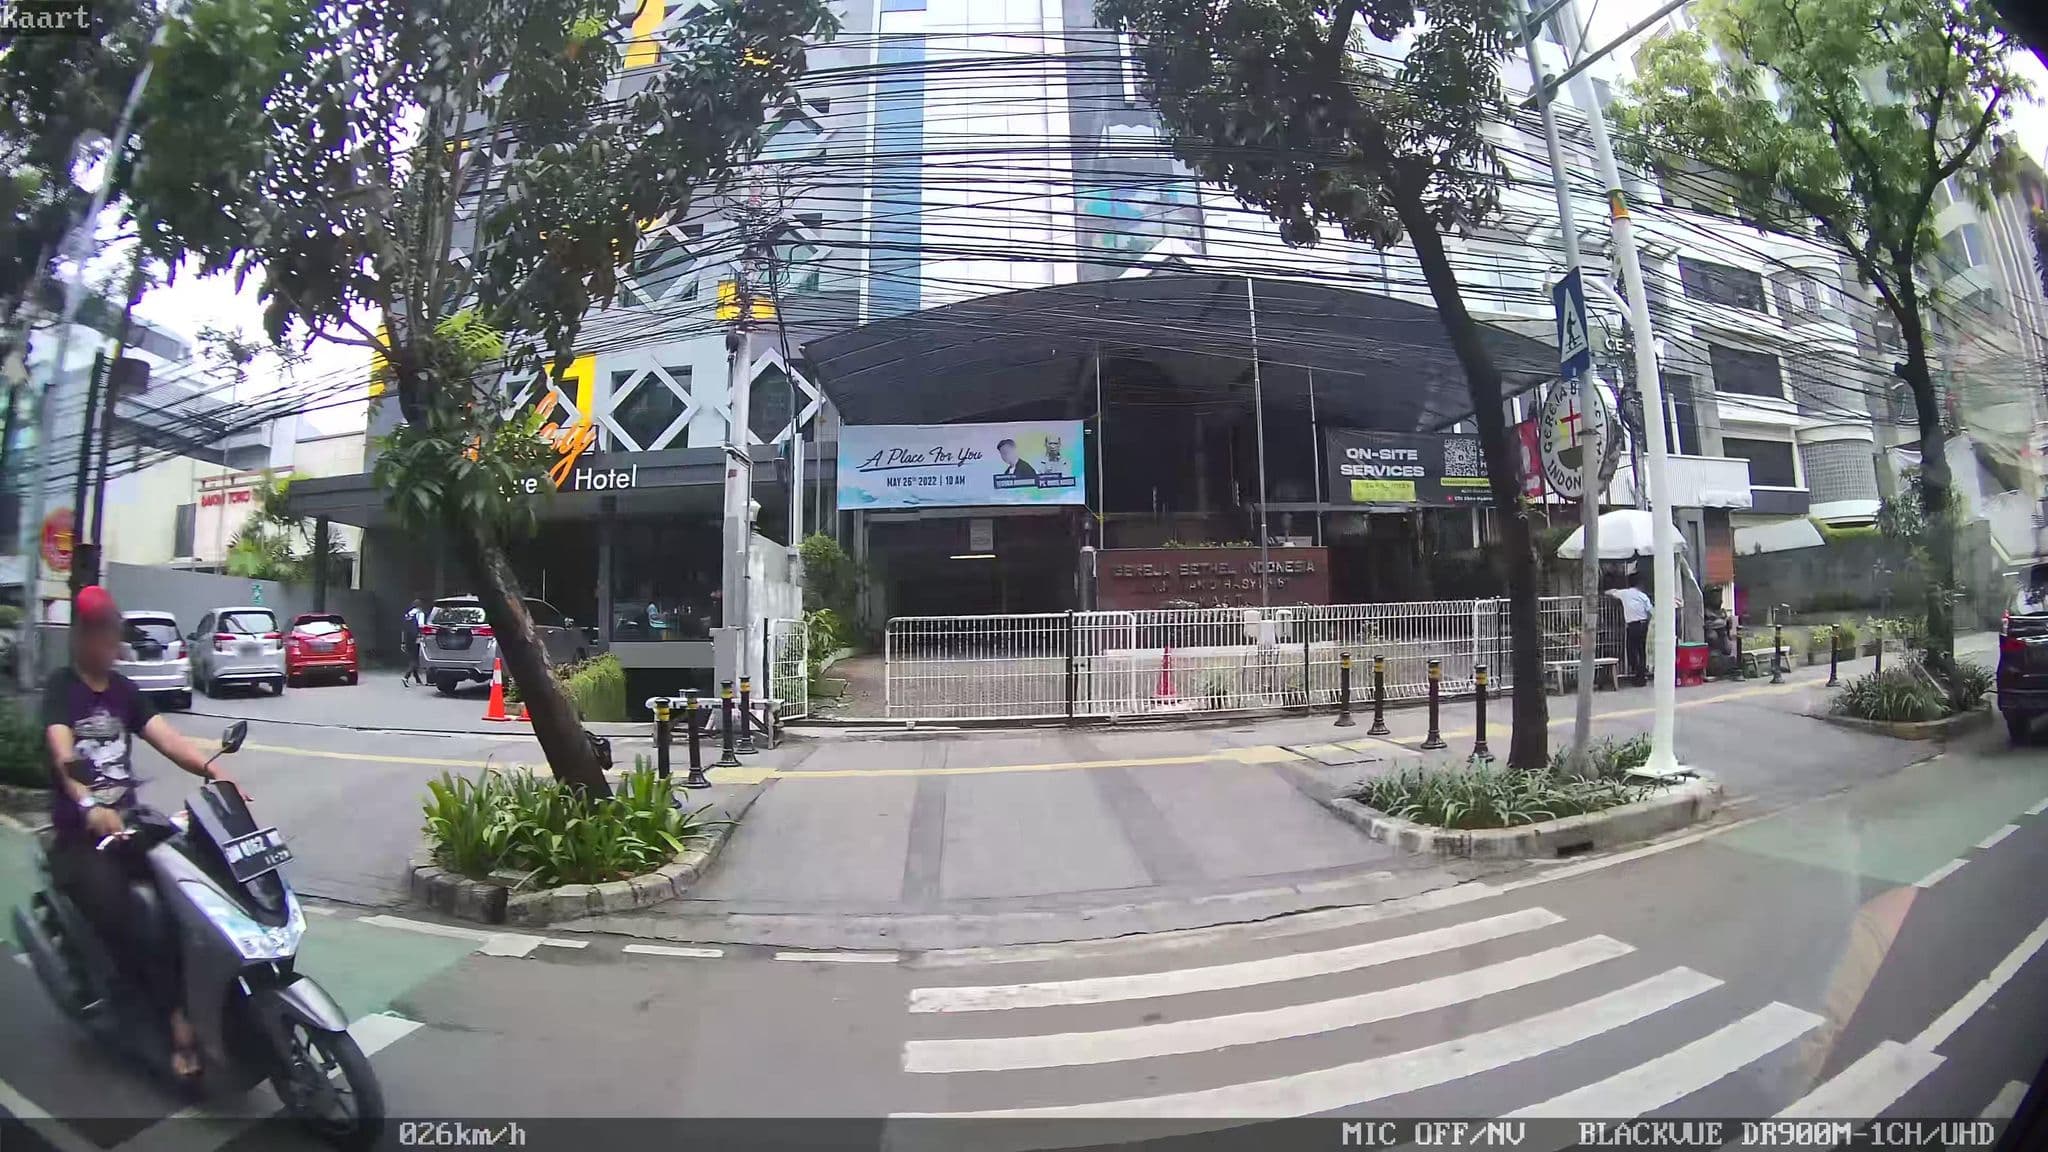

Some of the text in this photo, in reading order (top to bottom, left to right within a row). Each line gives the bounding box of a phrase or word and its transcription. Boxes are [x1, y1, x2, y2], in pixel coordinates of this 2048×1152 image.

[856, 445, 983, 469] A Place For You
[1346, 447, 1418, 461] ON-SITE
[575, 464, 637, 491] Hotel
[1340, 464, 1425, 478] SERVICES
[887, 477, 902, 488] MAY
[918, 475, 937, 486] 2022
[945, 475, 953, 486] 10
[954, 475, 966, 486] AM
